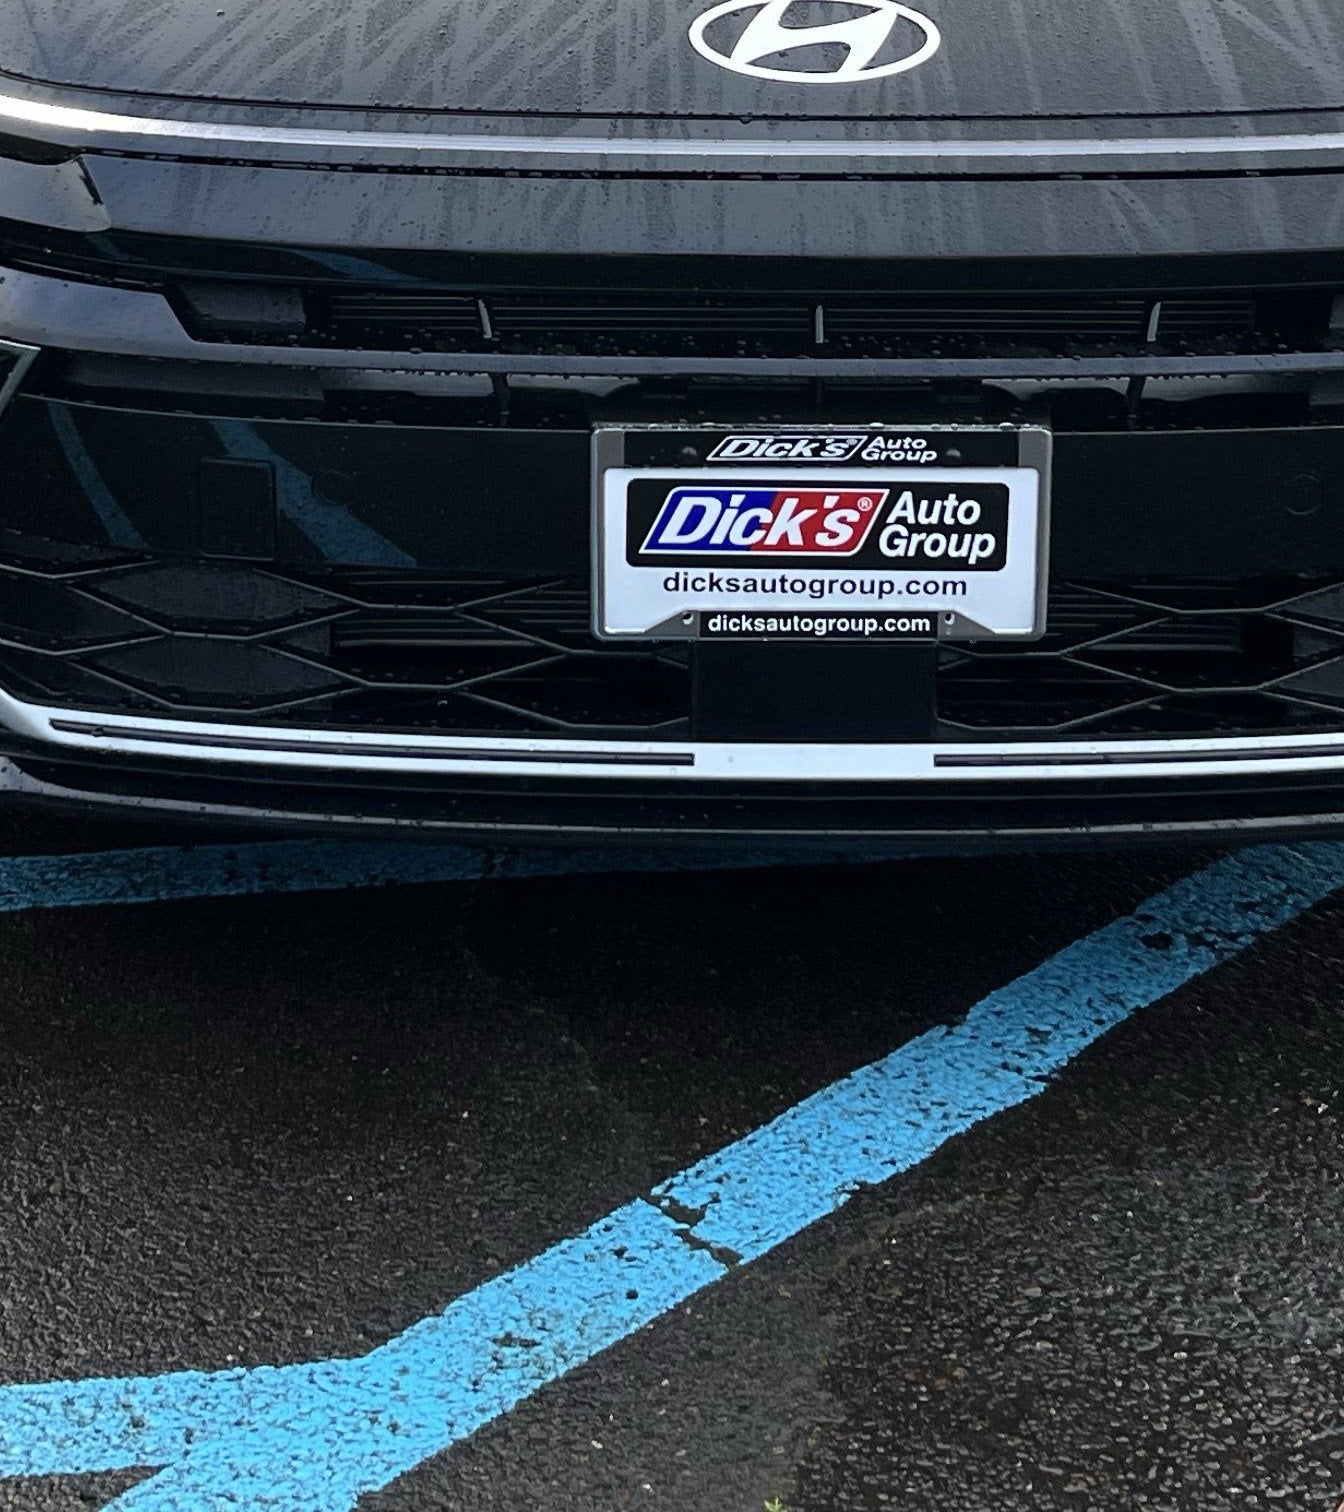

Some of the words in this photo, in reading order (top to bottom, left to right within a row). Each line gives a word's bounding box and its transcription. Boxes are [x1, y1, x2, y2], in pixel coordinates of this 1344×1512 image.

[720, 437, 850, 457] Dick's
[868, 436, 927, 450] Auto
[861, 448, 937, 464] Group
[657, 494, 860, 547] Dick's
[885, 491, 981, 525] Auto
[879, 524, 996, 564] Group
[663, 571, 967, 599] dicksautogroup.com
[708, 614, 930, 635] dicksautogroup.com
